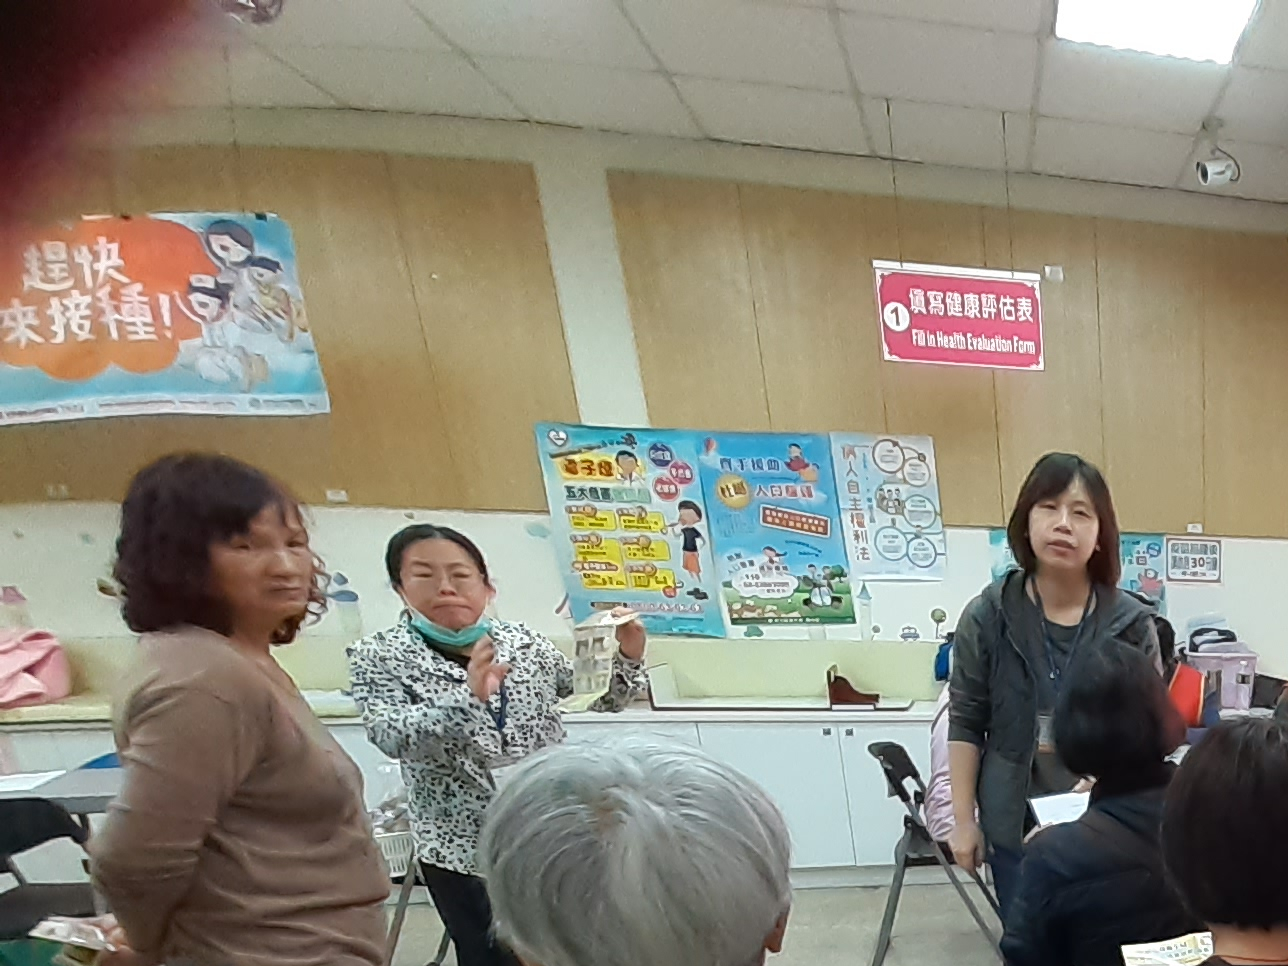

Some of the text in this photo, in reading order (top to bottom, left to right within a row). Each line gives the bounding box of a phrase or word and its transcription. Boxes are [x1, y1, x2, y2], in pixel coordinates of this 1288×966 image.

[0, 282, 172, 349] 來接種!
[909, 287, 1034, 323] 填寫健康評估表
[936, 331, 967, 350] Health
[967, 333, 1013, 352] Evaluation
[1014, 336, 1036, 355] Form
